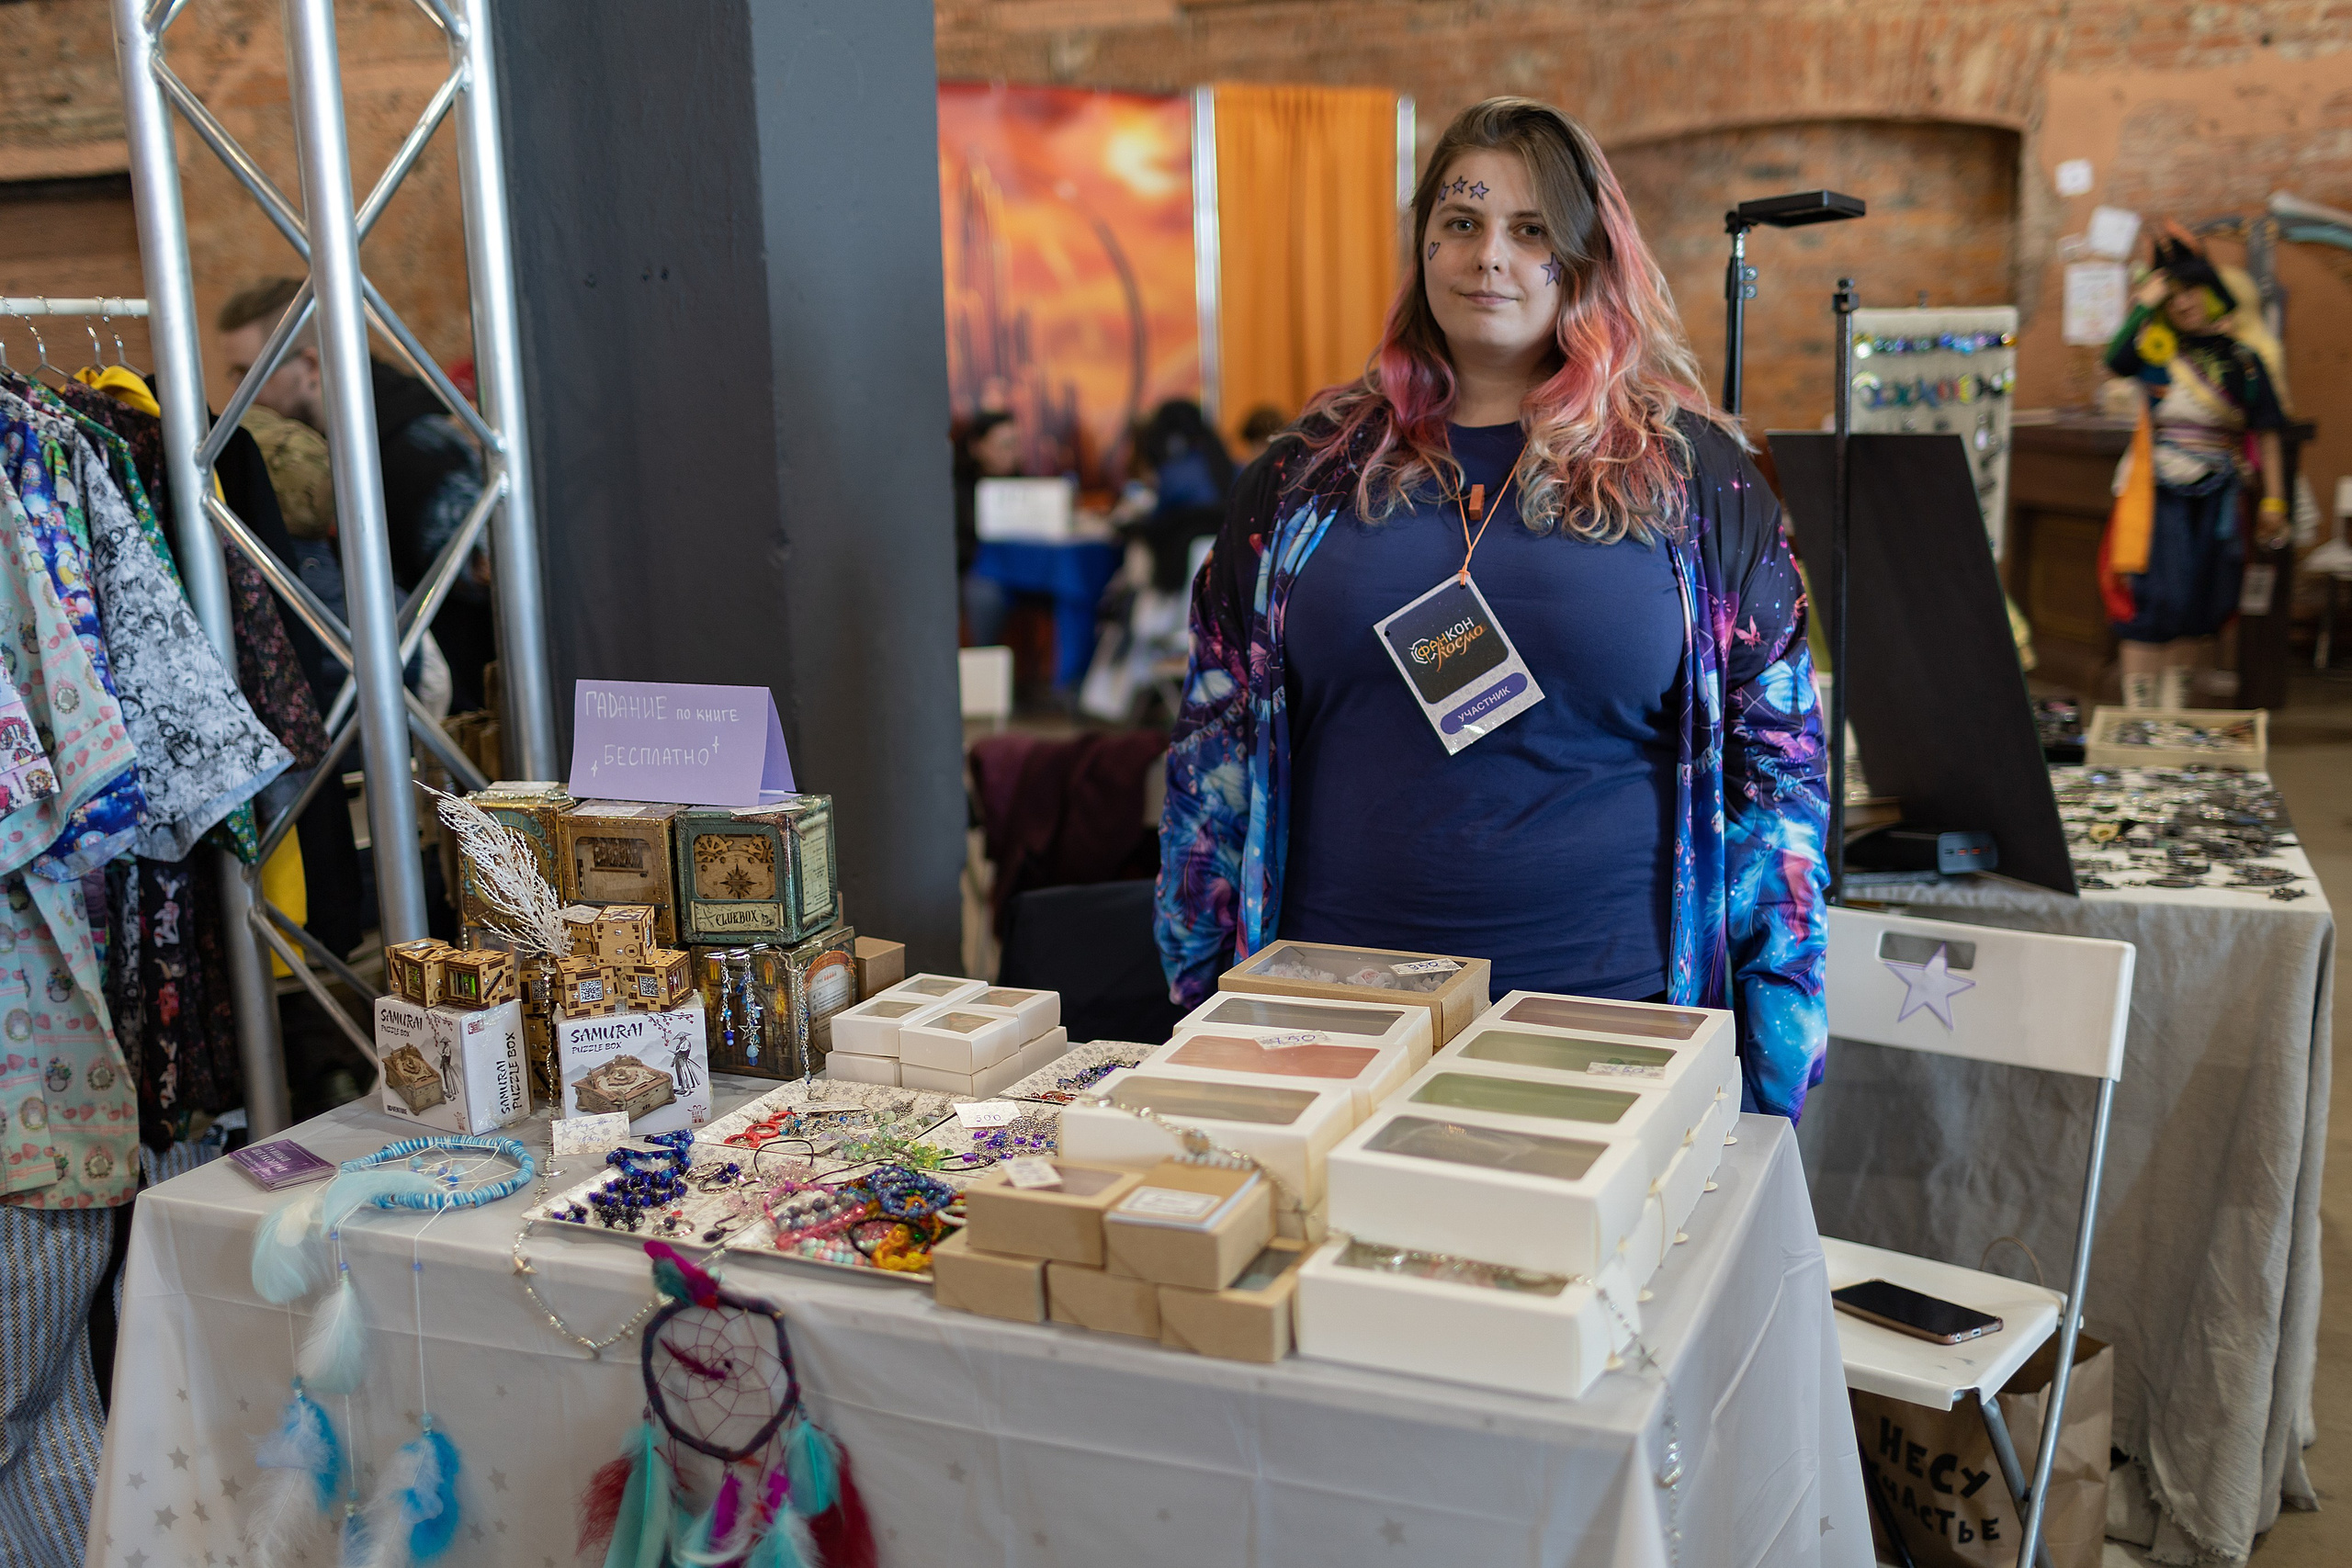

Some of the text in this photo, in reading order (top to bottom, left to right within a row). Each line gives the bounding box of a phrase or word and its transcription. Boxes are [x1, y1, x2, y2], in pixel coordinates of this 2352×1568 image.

[585, 691, 668, 720] ГАДАНИЕ
[1457, 685, 1511, 722] УЧАСТНИК
[604, 744, 709, 767] БЕСПЛАТНО
[716, 909, 759, 926] CLUEBOX
[380, 1009, 423, 1031] SAMURAI
[380, 1024, 411, 1037] PUZZLE BOX
[571, 1021, 643, 1043] SAMURAI
[571, 1041, 622, 1054] PUZZLE BOX
[505, 1032, 523, 1111] PUZZLE BOX
[496, 1060, 511, 1114] SAMURAI
[976, 1114, 1001, 1122] 500
[1879, 1416, 1991, 1499] НЕСУ
